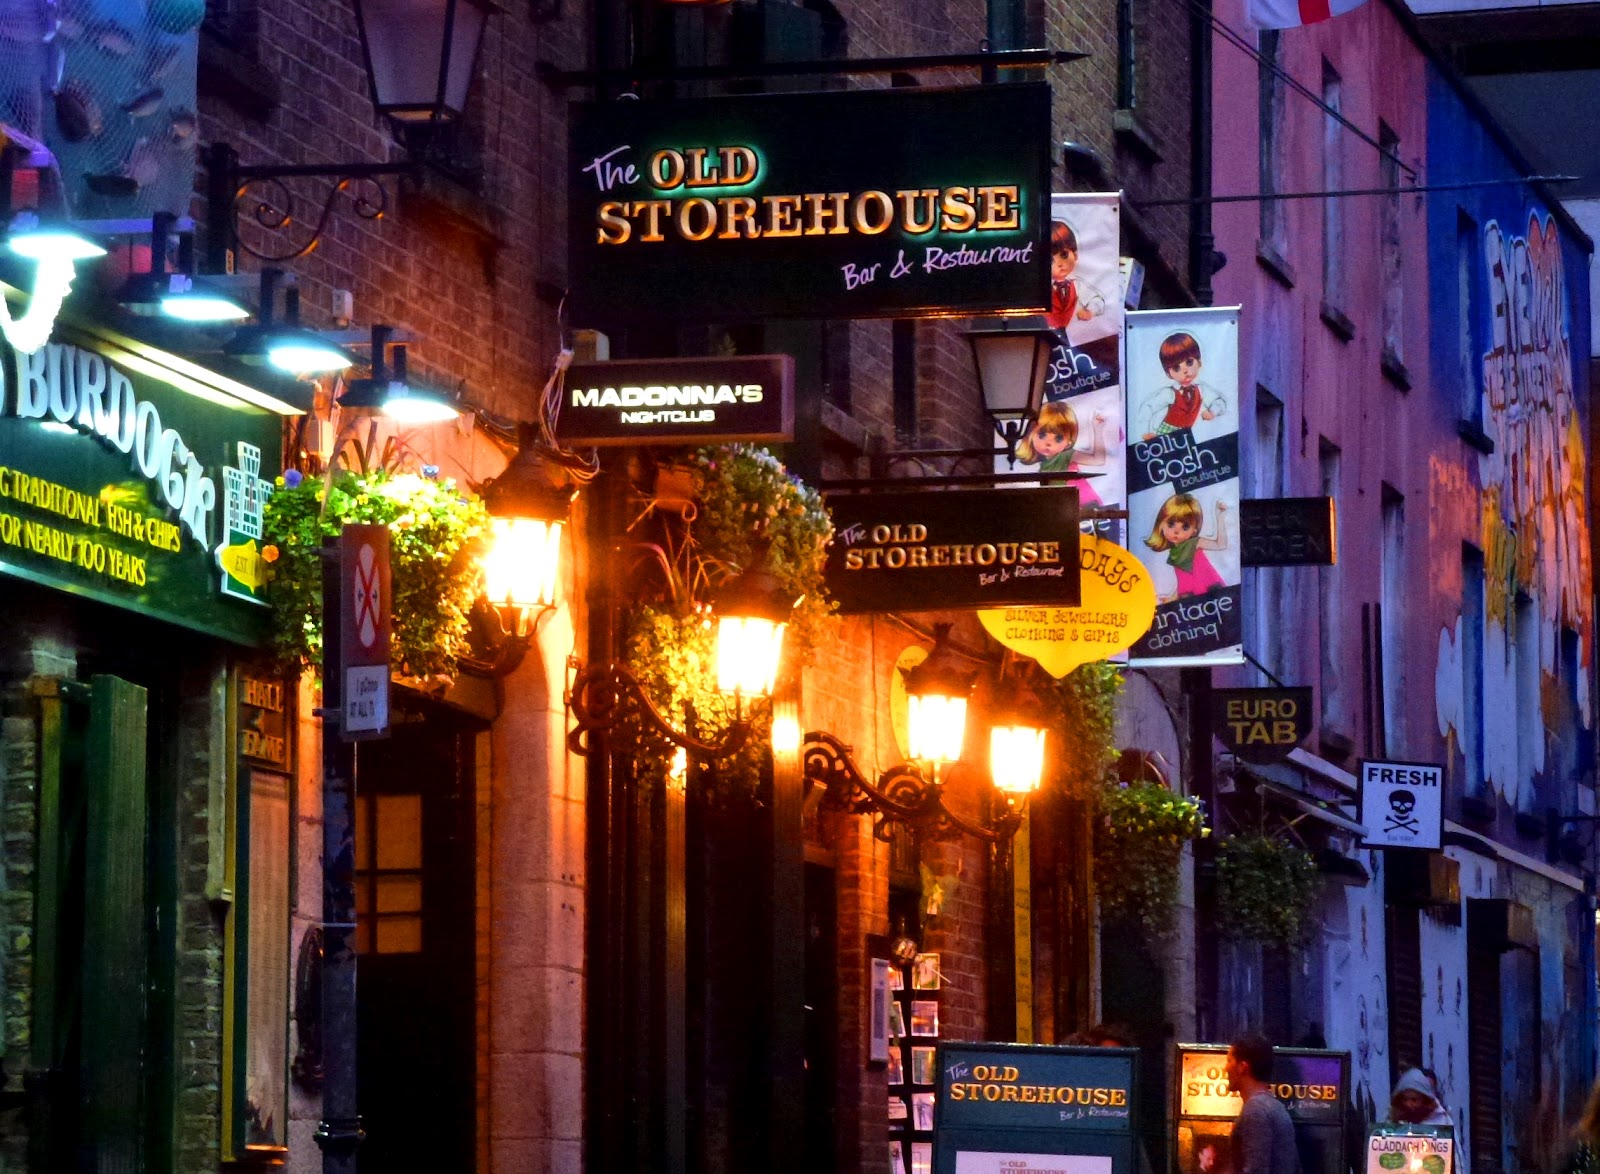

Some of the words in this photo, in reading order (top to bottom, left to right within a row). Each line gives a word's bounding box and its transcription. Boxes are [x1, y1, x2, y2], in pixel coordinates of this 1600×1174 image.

[582, 145, 640, 192] The
[651, 146, 757, 189] OLD
[597, 186, 1018, 245] STOREHOUSE
[840, 263, 882, 291] Bar
[889, 249, 915, 279] &
[922, 241, 1034, 274] Restaurant
[1052, 370, 1112, 395] boutique
[572, 384, 764, 407] MADONNA'S
[621, 409, 716, 424] NIGHTCLUB
[17, 343, 215, 552] BURDOCK
[1134, 433, 1192, 462] Golly
[1147, 446, 1219, 485] Gosh
[1180, 463, 1231, 488] boutique
[13, 469, 100, 528] TRADITIONAL
[134, 509, 145, 541] &
[147, 519, 181, 553] CHIPS
[838, 522, 867, 547] The
[871, 523, 928, 545] OLD
[24, 520, 75, 562] NEARLY
[78, 538, 105, 573] 100
[108, 549, 146, 586] YEARS
[845, 541, 1060, 570] STOREHOUSE
[979, 572, 998, 586] Bar
[1001, 568, 1010, 582] &
[1014, 565, 1065, 578] Restaurant
[1155, 596, 1233, 630] intage
[1148, 622, 1220, 650] clothing
[1227, 699, 1297, 719] EURO
[1227, 721, 1297, 745] TAB
[1368, 767, 1437, 787] FRESH
[945, 1061, 970, 1081] The
[973, 1065, 1019, 1081] OLD
[951, 1083, 1127, 1106] STOREHOUSE
[1059, 1110, 1074, 1121] Bar
[1077, 1108, 1086, 1119] &
[1088, 1106, 1129, 1118] Restaurant
